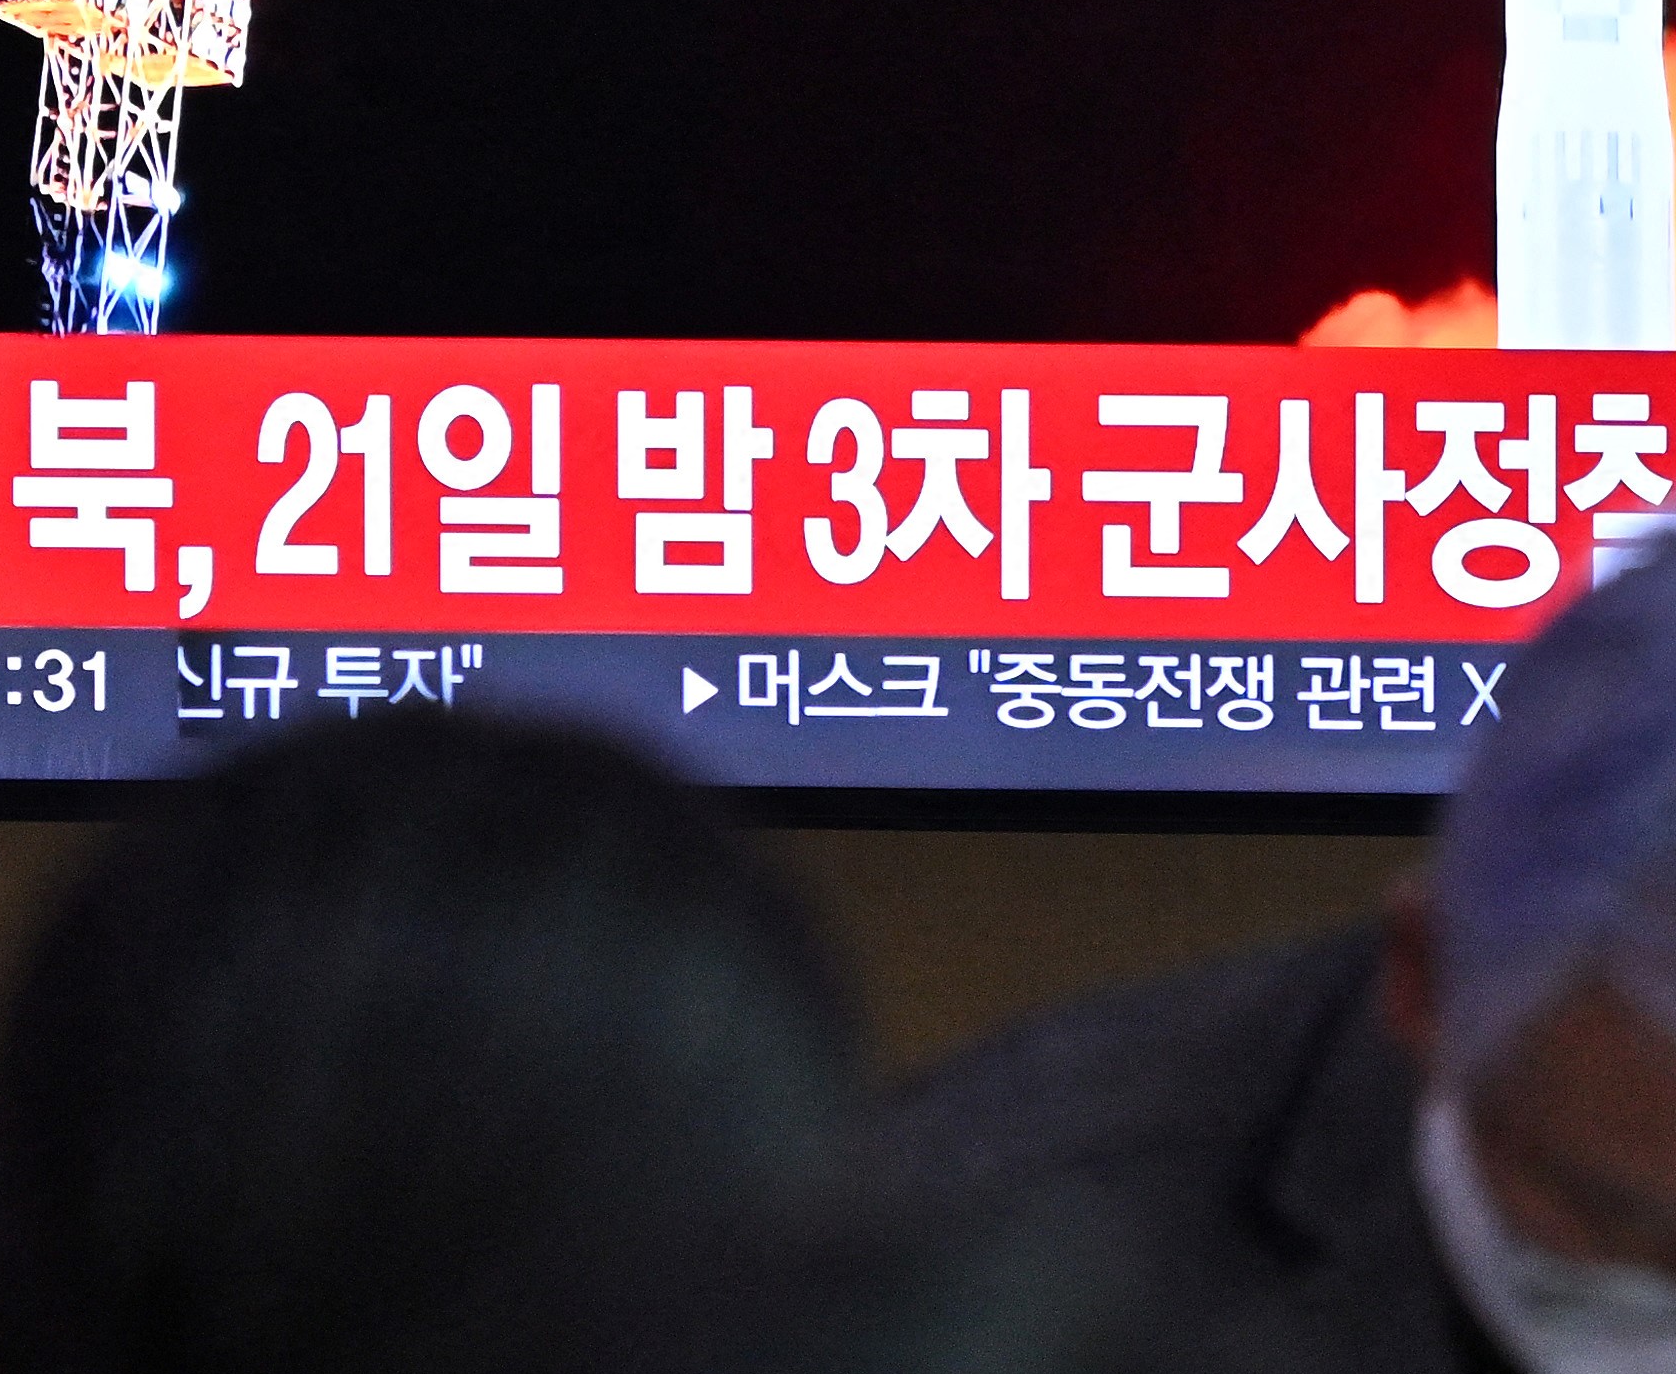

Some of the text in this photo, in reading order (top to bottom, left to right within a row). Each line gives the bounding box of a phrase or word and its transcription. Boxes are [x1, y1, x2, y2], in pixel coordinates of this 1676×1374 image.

[13, 381, 213, 619] 북,
[256, 384, 563, 593] 21일
[618, 386, 774, 594] 밤
[804, 389, 1052, 600] 3차
[318, 643, 483, 718] 투자"
[738, 650, 949, 725] 머스크
[969, 648, 1274, 730] "중동전쟁
[1297, 655, 1436, 730] 관련
